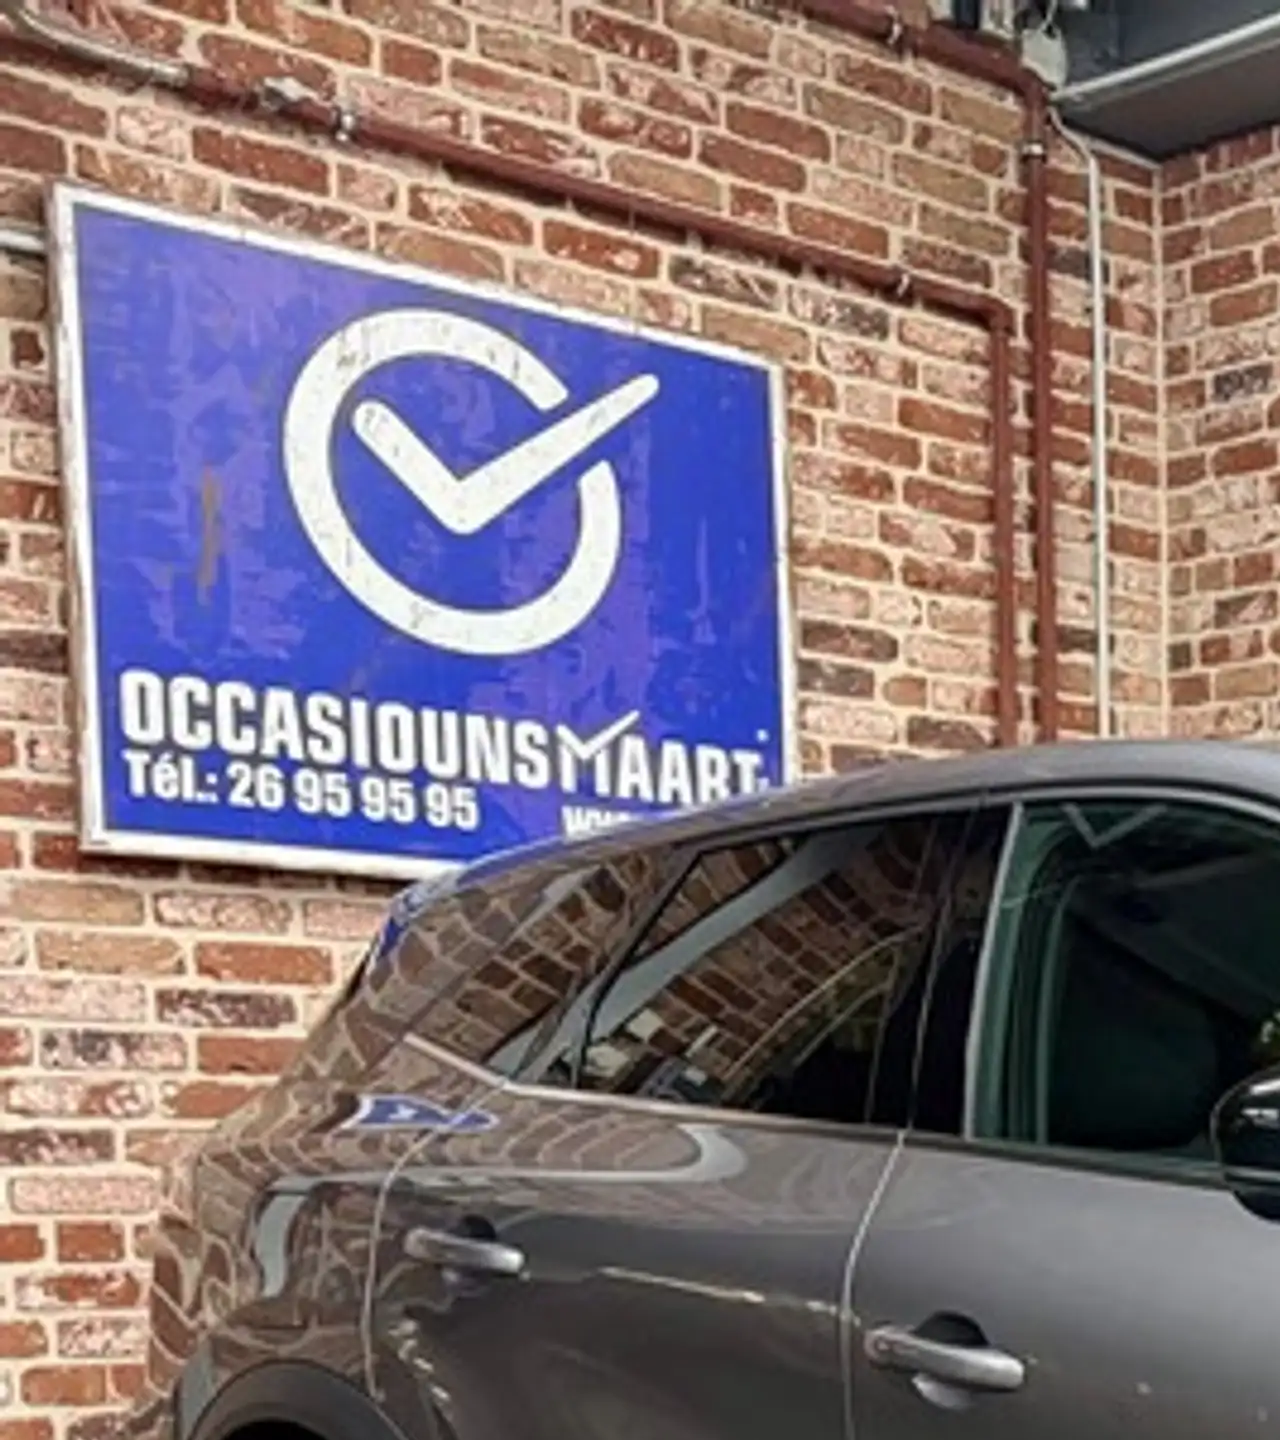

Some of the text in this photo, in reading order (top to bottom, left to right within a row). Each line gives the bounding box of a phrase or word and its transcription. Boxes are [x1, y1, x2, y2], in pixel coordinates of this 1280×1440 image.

[226, 761, 285, 811] 26
[295, 768, 350, 816] 95
[361, 776, 415, 823] 95
[425, 782, 477, 829] 95
